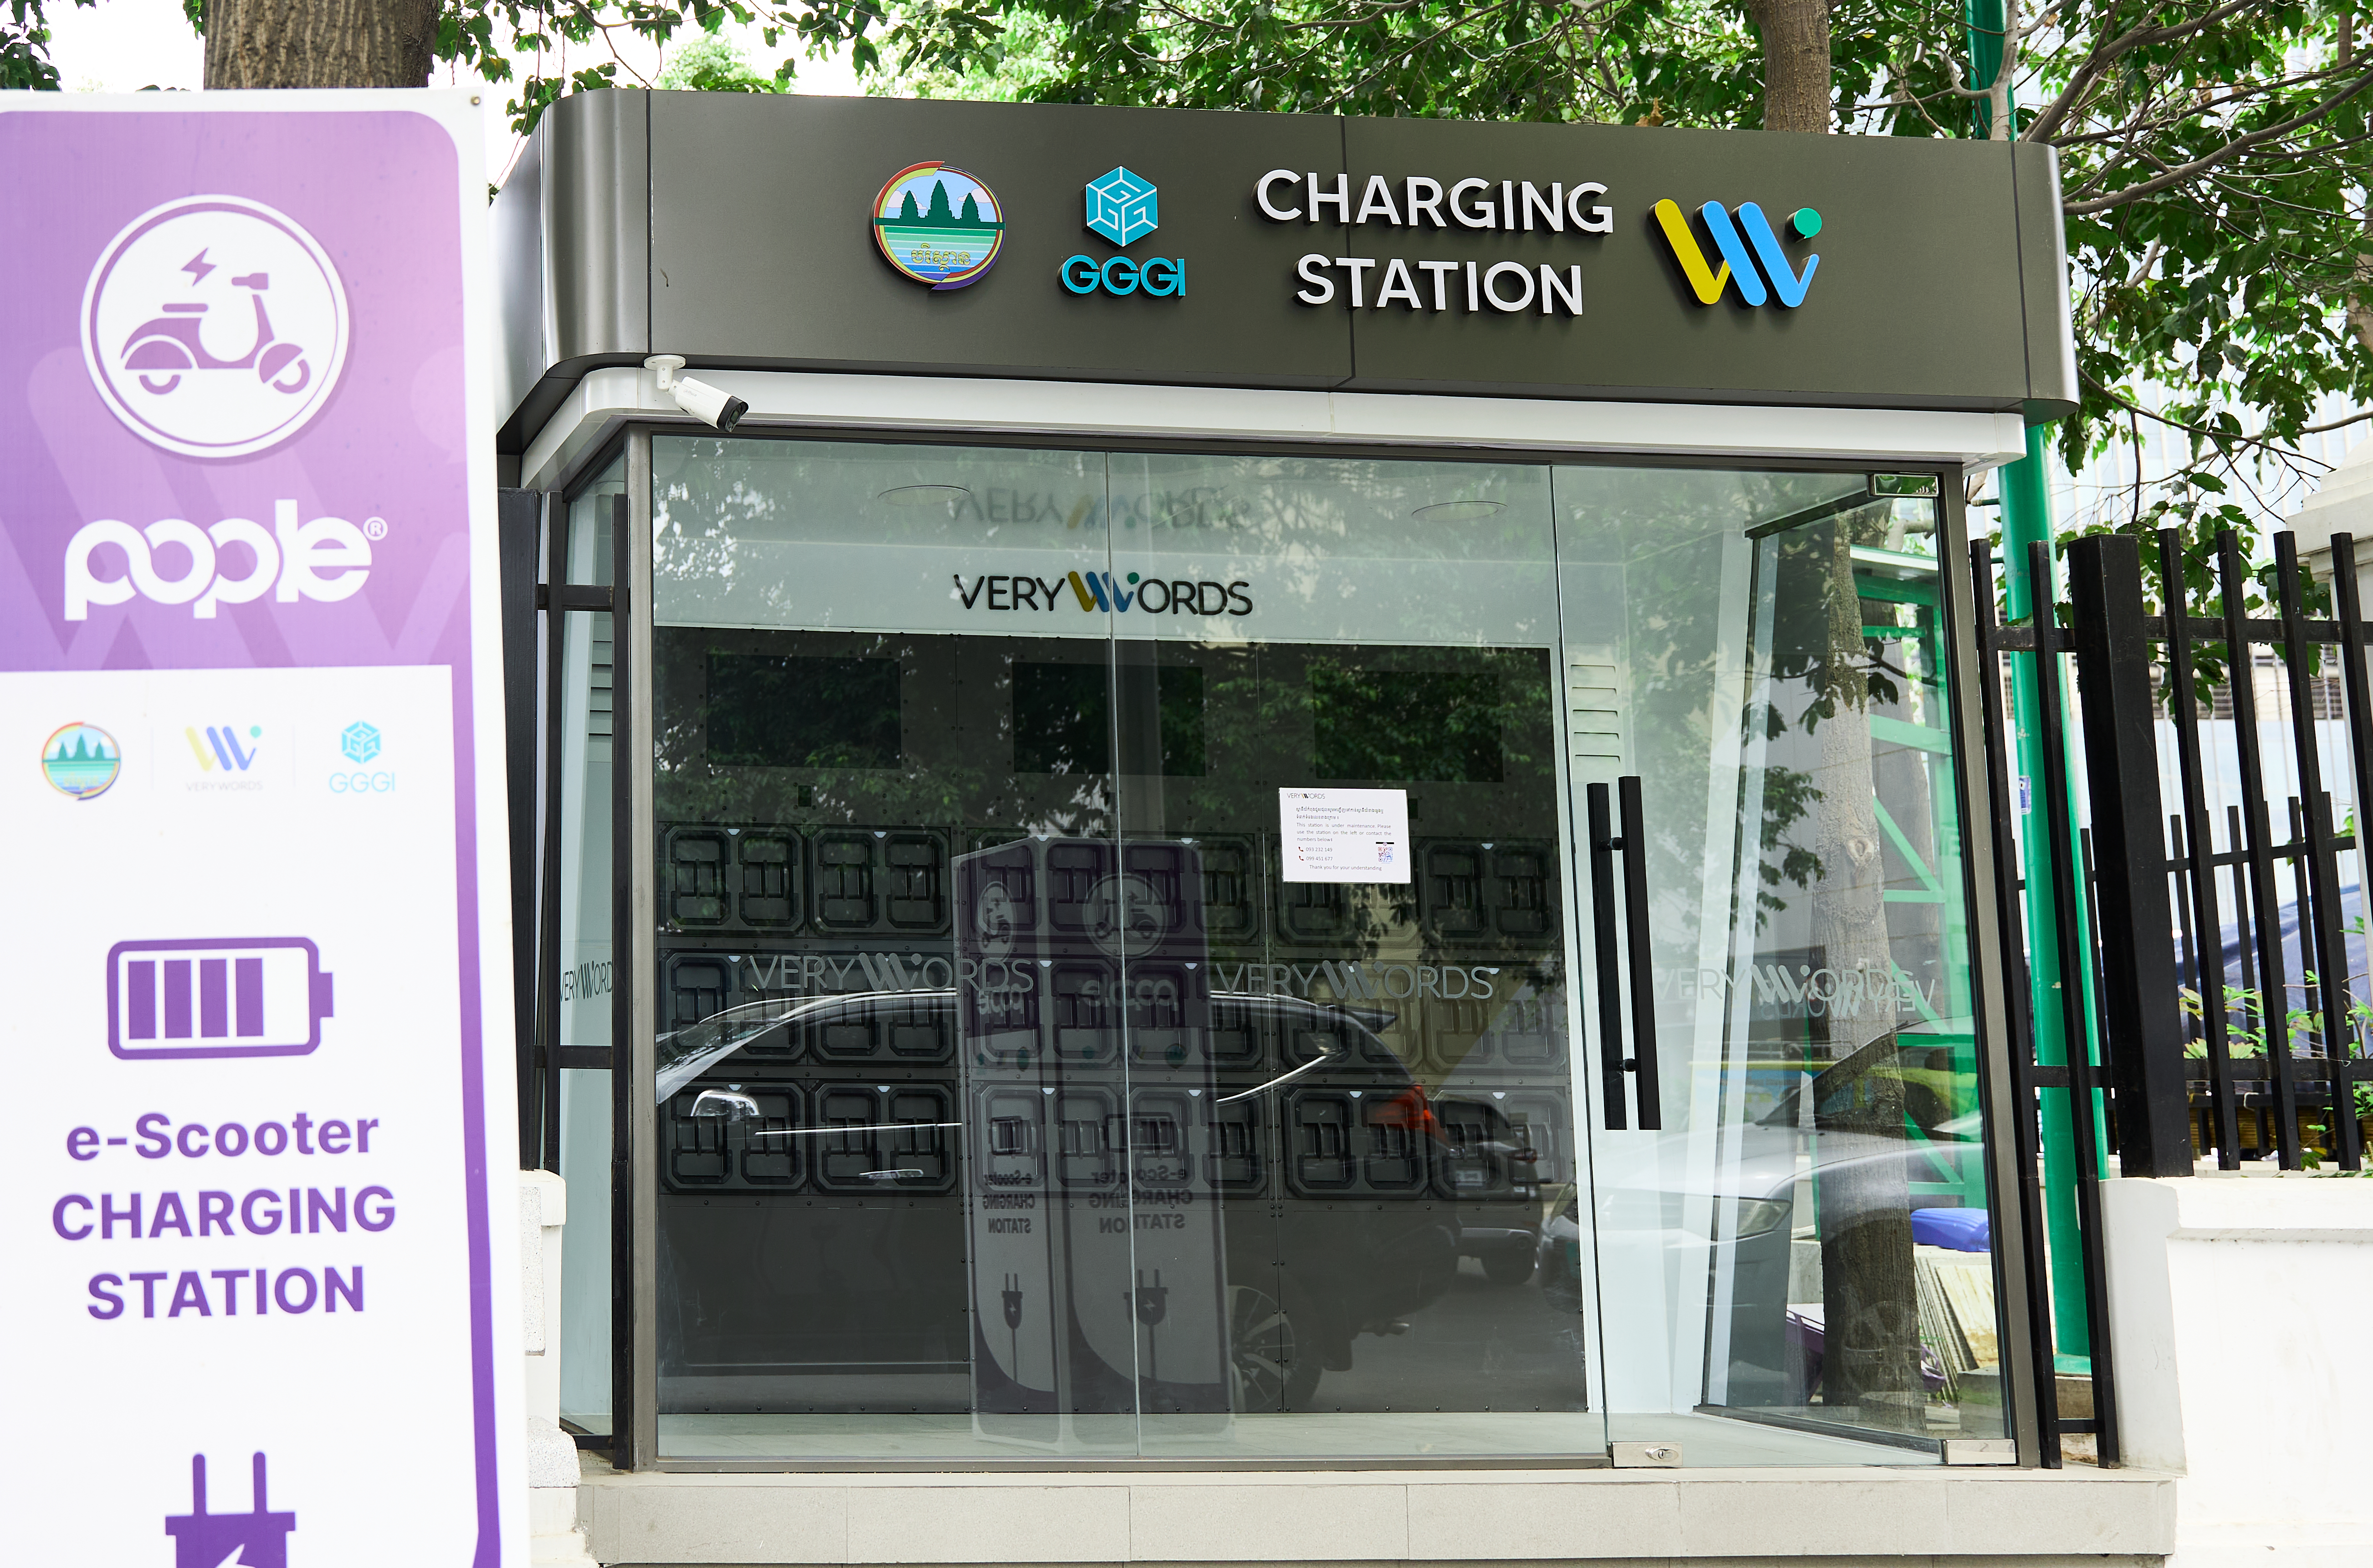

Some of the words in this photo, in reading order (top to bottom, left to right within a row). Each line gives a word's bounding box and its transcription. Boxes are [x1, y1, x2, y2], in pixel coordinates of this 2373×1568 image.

[1256, 169, 1614, 234] CHARGING
[911, 242, 971, 271] បរិស្ថាន
[1061, 254, 1186, 297] GGGI
[1297, 253, 1582, 316] STATION
[328, 772, 395, 793] GGGI
[66, 1112, 379, 1161] e-Scooter
[52, 1185, 396, 1240] CHARGING
[87, 1266, 364, 1320] STATION
